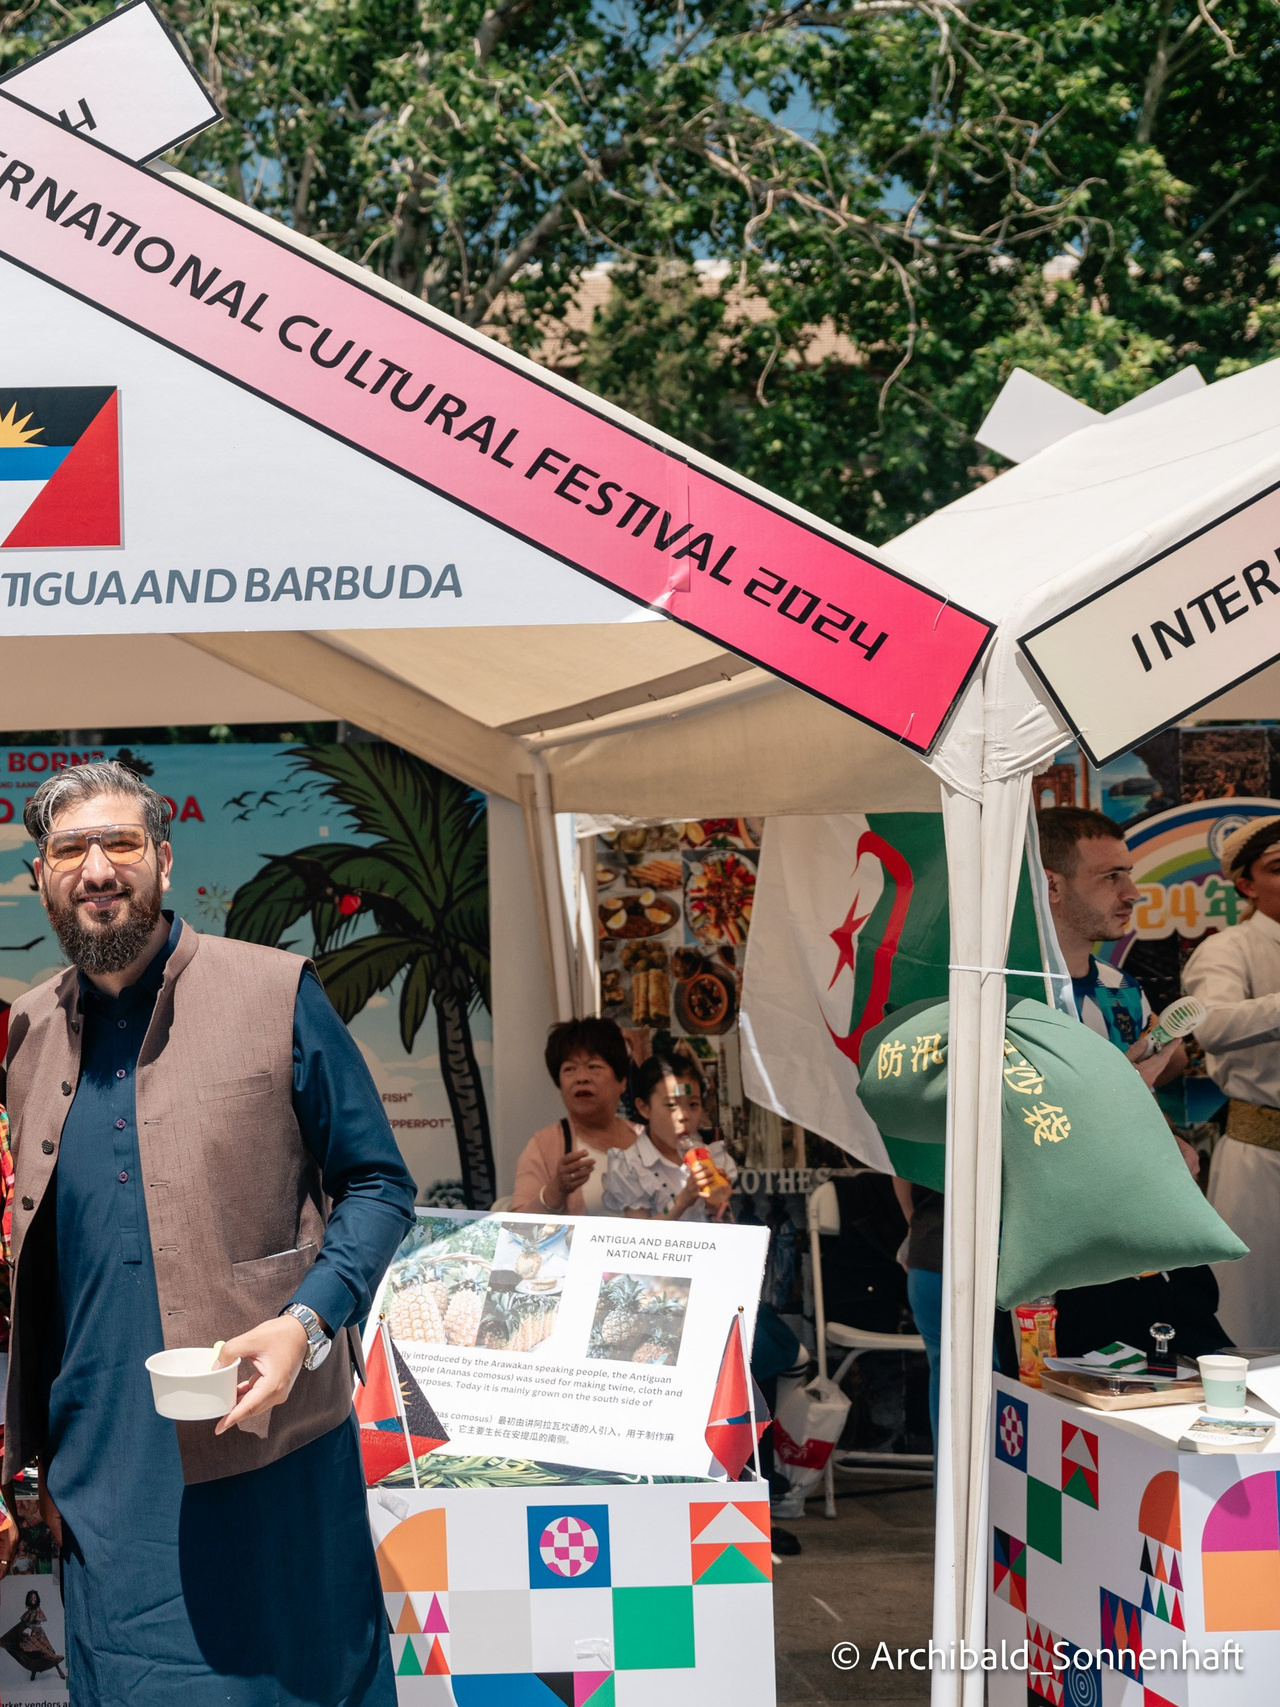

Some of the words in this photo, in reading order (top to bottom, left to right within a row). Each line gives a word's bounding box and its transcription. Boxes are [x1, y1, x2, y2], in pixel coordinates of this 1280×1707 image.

[278, 315, 520, 469] CULTURAL
[523, 447, 738, 586] FESTIVAL
[743, 566, 890, 662] 2024
[244, 564, 463, 603] BARBUDA
[590, 1234, 636, 1246] ANTIGUA
[638, 1237, 662, 1248] AND
[665, 1239, 717, 1251] BARBUDA
[606, 1249, 659, 1261] NATIONAL
[661, 1252, 693, 1263] FRUIT
[412, 1351, 459, 1363] introduced
[460, 1356, 470, 1366] by
[474, 1357, 488, 1366] the
[489, 1359, 533, 1370] Arawakan
[534, 1363, 574, 1376] speaking
[575, 1367, 610, 1380] people,
[611, 1370, 627, 1380] the
[629, 1372, 672, 1386] Antiguan
[436, 1366, 470, 1378] (Ananas
[472, 1369, 513, 1382] comosus)
[534, 1375, 556, 1385] used
[557, 1377, 570, 1386] for
[573, 1379, 605, 1391] making
[607, 1382, 636, 1394] twine,
[638, 1385, 662, 1395] cloth
[664, 1388, 682, 1397] and
[417, 1377, 452, 1389] urposes.
[455, 1380, 481, 1392] Today
[484, 1382, 489, 1391] it
[491, 1383, 498, 1391] is
[500, 1384, 530, 1396] mainly
[531, 1389, 559, 1399] grown
[575, 1391, 590, 1400] the
[592, 1393, 618, 1403] south
[620, 1396, 640, 1405] side
[642, 1398, 653, 1407] of
